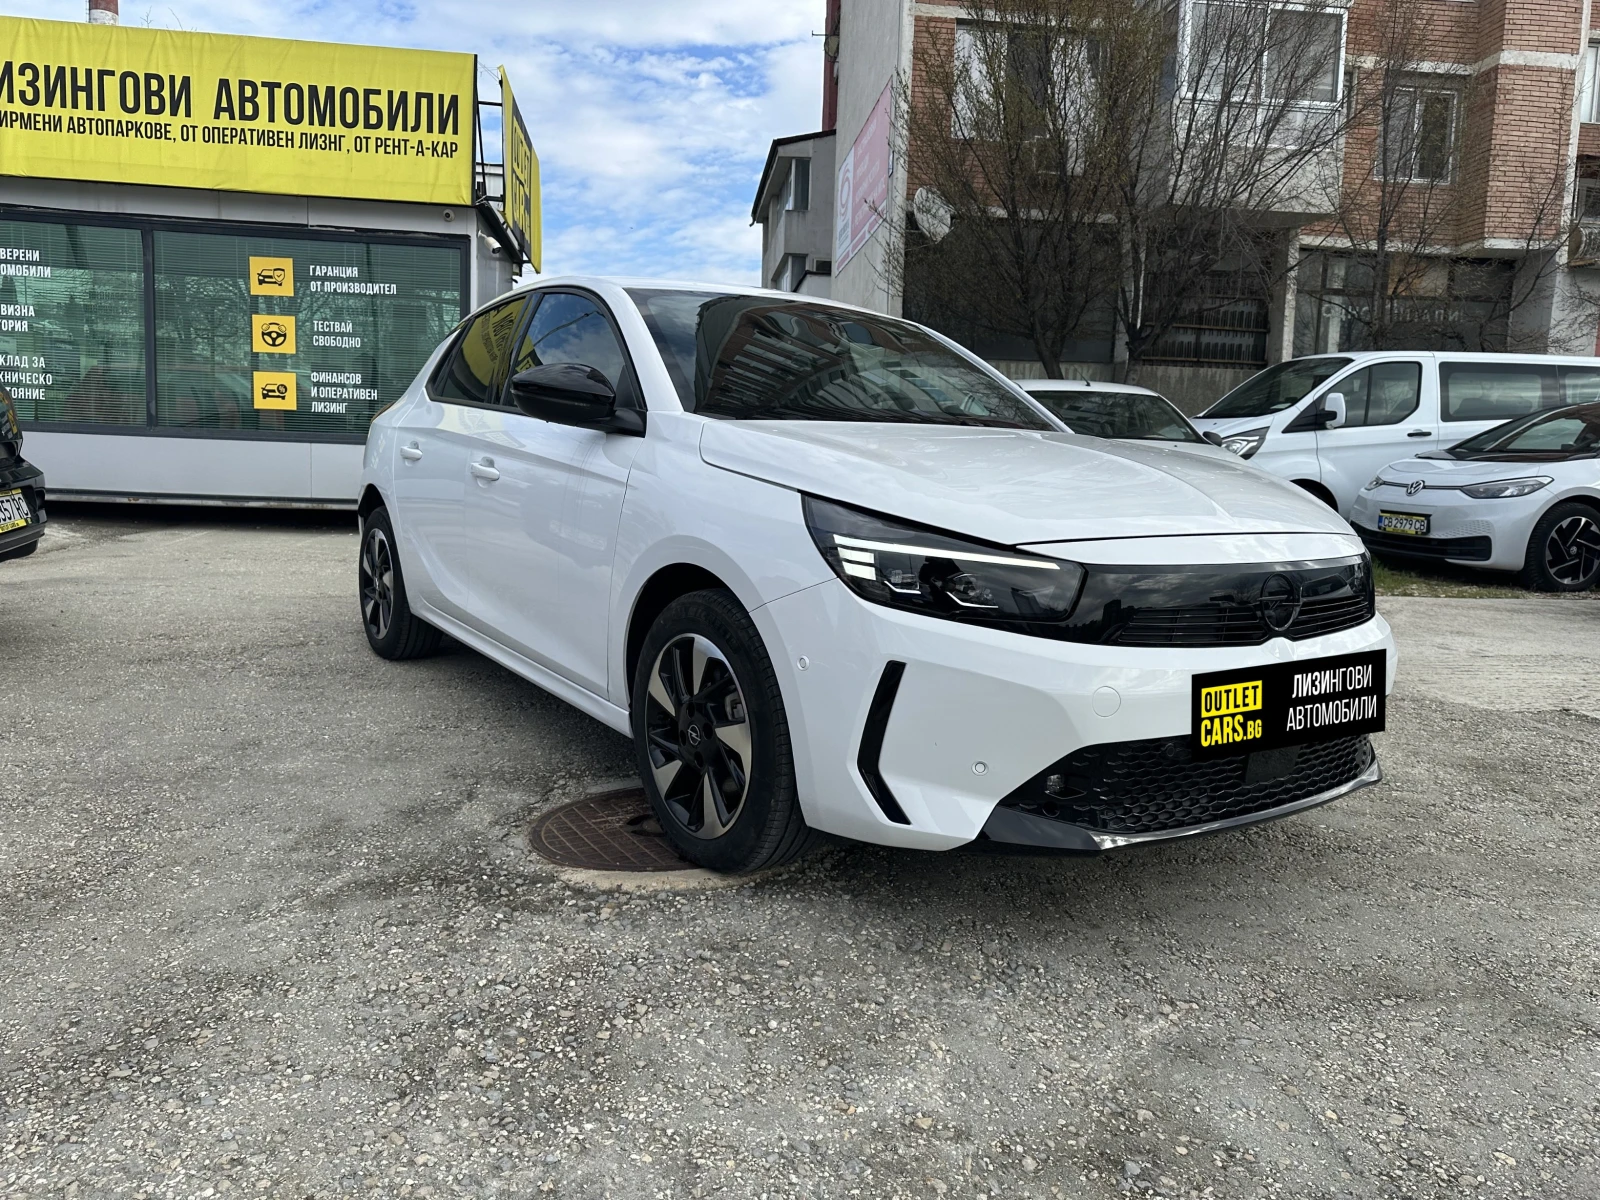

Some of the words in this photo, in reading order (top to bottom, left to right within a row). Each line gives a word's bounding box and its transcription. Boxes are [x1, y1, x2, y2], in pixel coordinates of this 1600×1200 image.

[213, 78, 459, 136] АВТОМОБИЛИ
[67, 116, 177, 143] АВТОПАРКОВЕ,
[181, 124, 198, 143] ОТ
[202, 125, 294, 149] ОПЕРАТИВЕН
[354, 135, 371, 154] ОТ
[375, 136, 458, 159] РЕНТ-А-КАР
[513, 124, 530, 191] OUTET
[0, 263, 51, 278] ОМОБИЛИ
[309, 265, 358, 279] ГАРАНЦИЯ
[310, 281, 322, 292] ОТ
[324, 281, 397, 295] ПРОИЗВОДИТЕЛ
[0, 319, 29, 332] ОРИЯ
[313, 320, 353, 333] ТЕСТВАЙ
[313, 335, 361, 349] СВОБОДНО
[32, 356, 46, 368] ЗА
[310, 371, 362, 385] ФИНАНСОВ
[311, 386, 318, 398] И
[319, 386, 378, 400] ОПЕРАТИВЕН
[311, 401, 348, 414] ЛИЗИНГ
[1393, 518, 1413, 530] 2979
